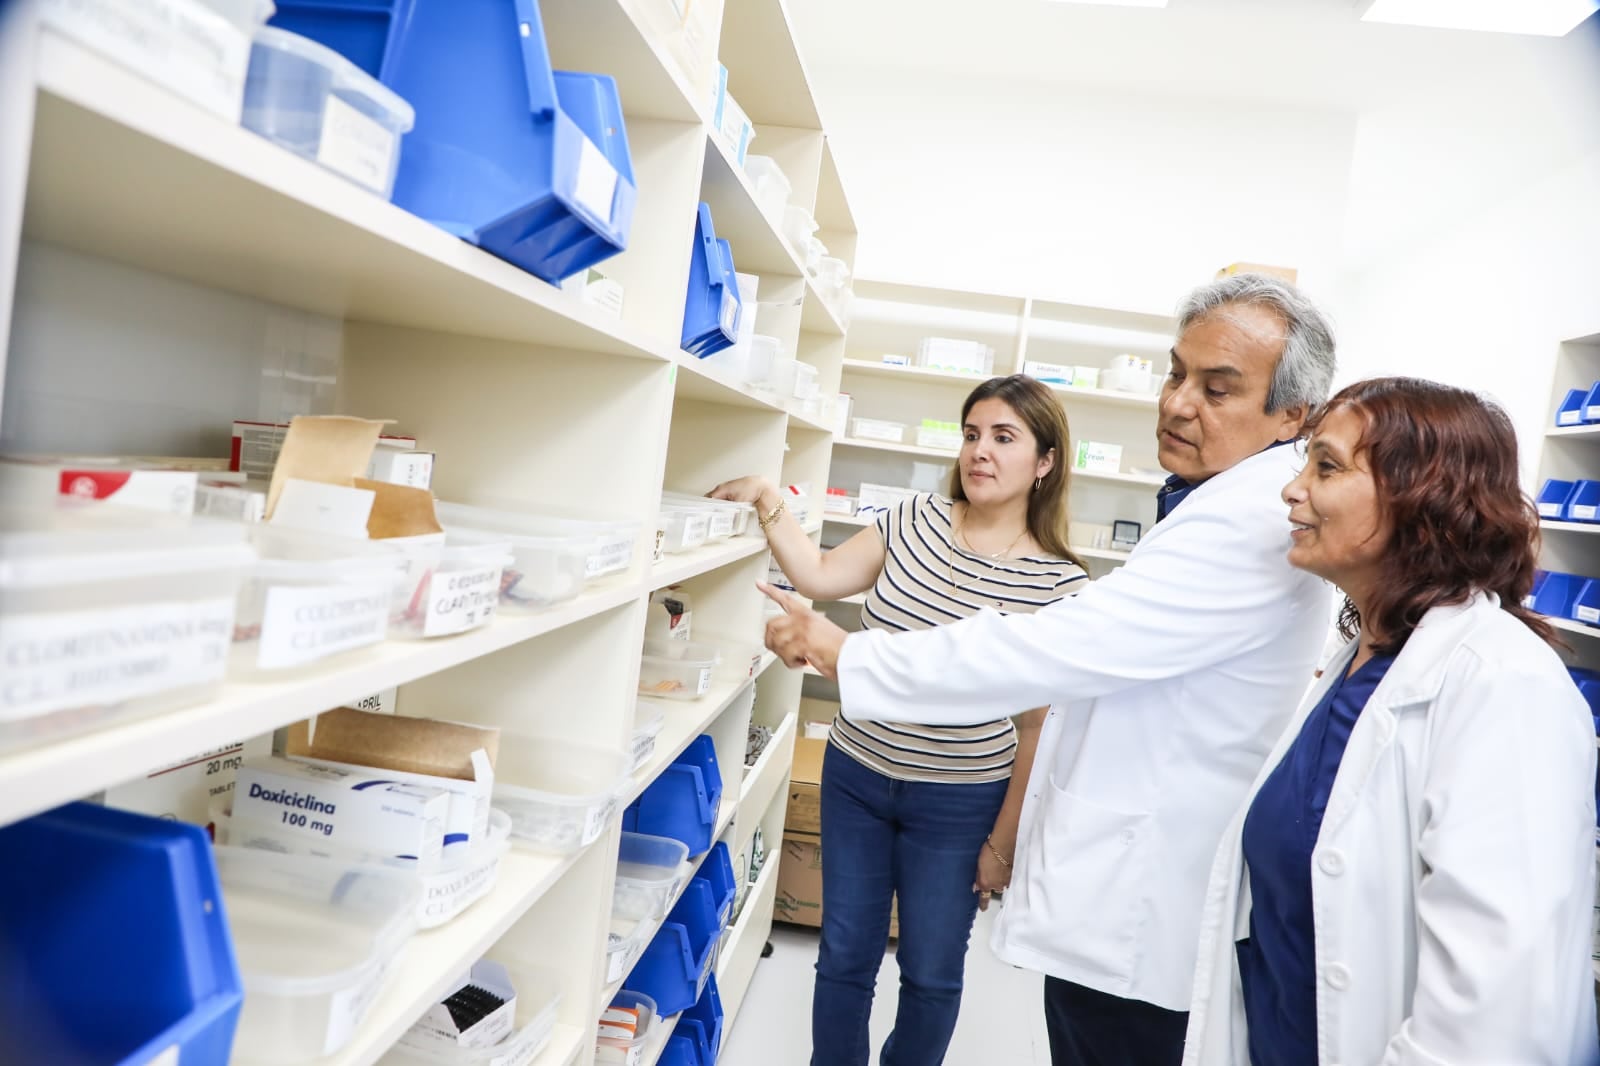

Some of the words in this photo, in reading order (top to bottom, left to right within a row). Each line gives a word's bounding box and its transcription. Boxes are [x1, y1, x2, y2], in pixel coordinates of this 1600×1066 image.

[1083, 452, 1104, 462] Creon
[358, 693, 381, 709] PRIL
[206, 759, 220, 776] 20
[248, 782, 336, 816] Doxiciclina
[281, 811, 307, 828] 100
[310, 820, 334, 836] mg
